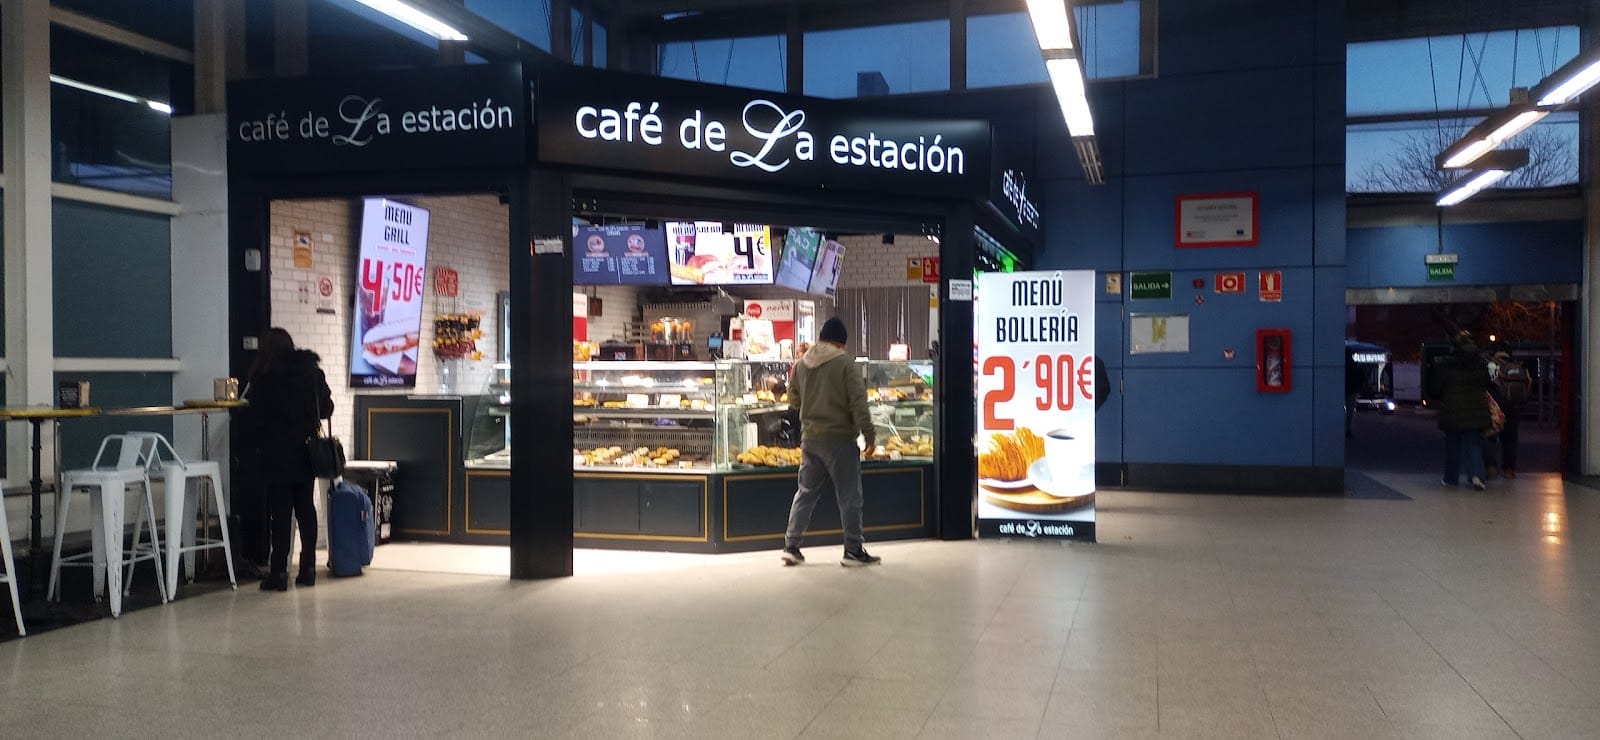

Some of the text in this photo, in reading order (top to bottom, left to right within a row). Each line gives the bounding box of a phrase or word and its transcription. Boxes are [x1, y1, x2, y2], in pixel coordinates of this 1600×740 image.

[239, 110, 287, 142] café
[299, 111, 329, 138] de
[401, 98, 513, 133] estación
[575, 102, 663, 145] café
[679, 110, 727, 152] de
[830, 135, 965, 174] estación
[384, 225, 410, 245] GRILL
[1012, 273, 1063, 306] MENÚ
[1133, 282, 1161, 290] SALIDA
[996, 310, 1078, 343] BOLLERÍA
[999, 522, 1015, 534] café
[1016, 523, 1026, 534] de
[1043, 524, 1074, 536] estación
